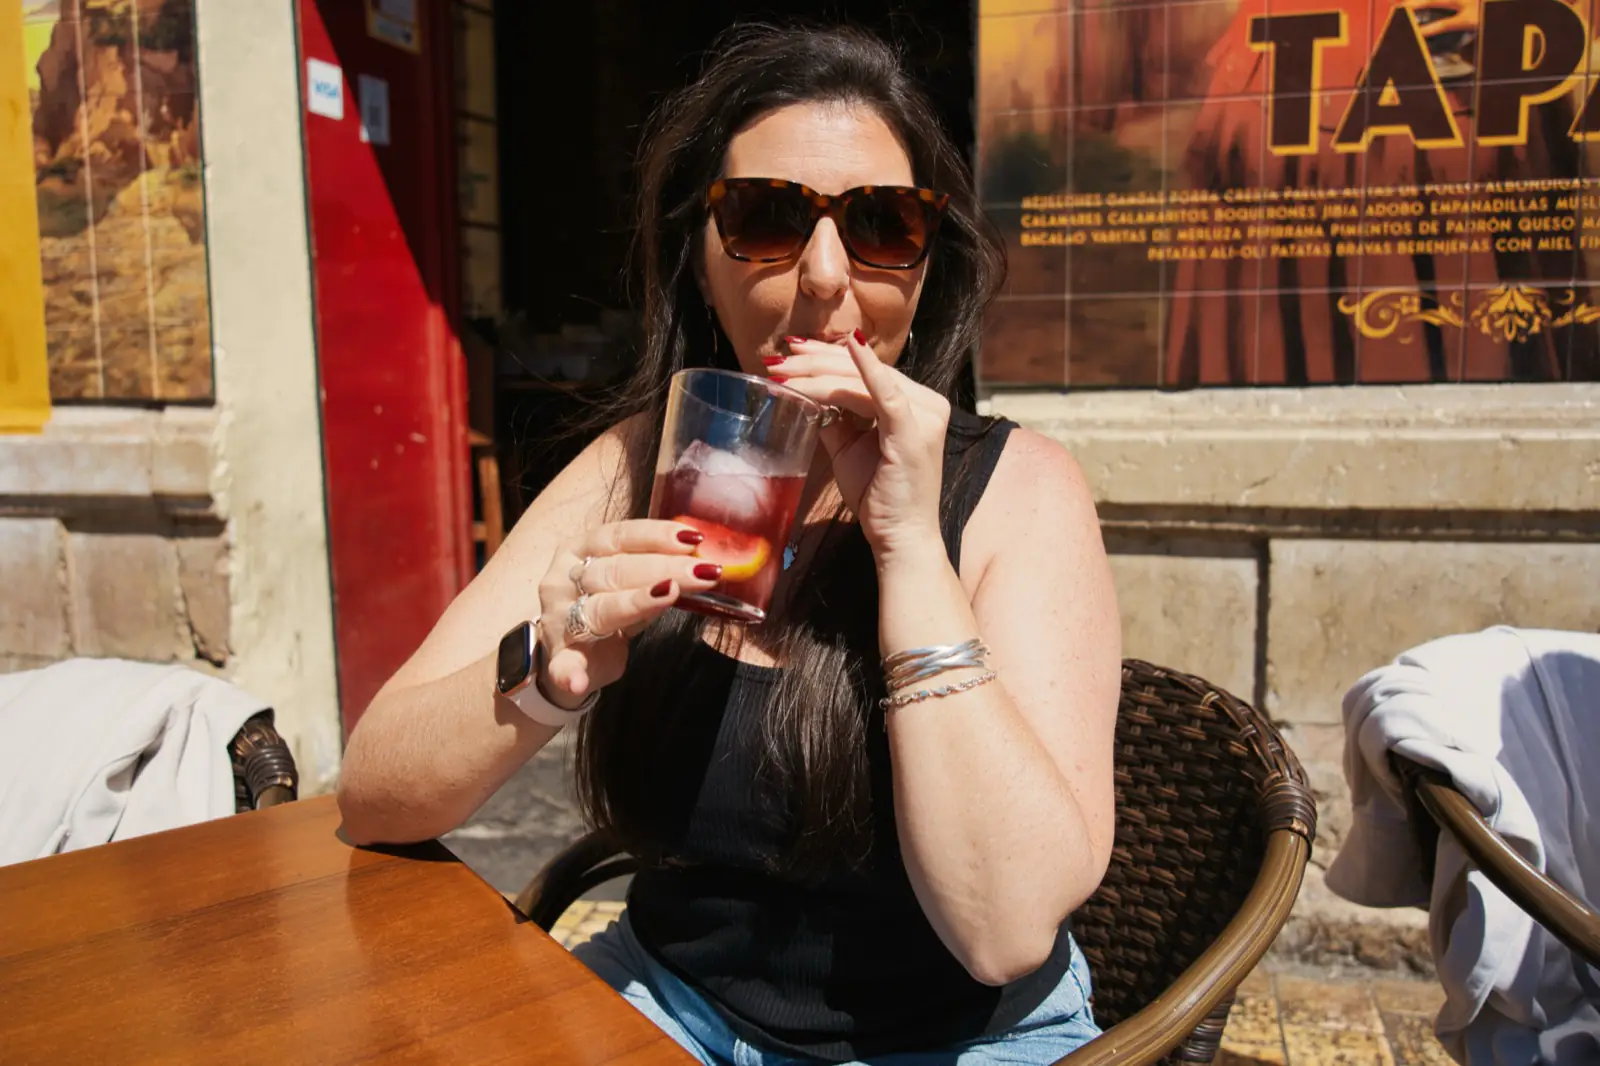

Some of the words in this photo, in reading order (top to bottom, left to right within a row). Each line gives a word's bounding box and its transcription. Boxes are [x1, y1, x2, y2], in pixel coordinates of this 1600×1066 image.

[1246, 0, 1600, 155] TAP
[1021, 211, 1102, 228] CALAMARES
[1107, 209, 1209, 225] CALAMARITOS
[1214, 205, 1316, 222] BOQUERONES
[1365, 201, 1424, 217] ADOBO
[1430, 196, 1548, 215] EMPANADILLAS
[1091, 228, 1147, 244] VARITAS
[1152, 227, 1172, 243] DE
[1176, 225, 1242, 242] MERLUZA
[1330, 220, 1412, 238] PIMIENTOS
[1418, 219, 1440, 235] DE
[1446, 215, 1513, 234] PADRÓN
[1518, 215, 1576, 232] QUESO
[1148, 246, 1207, 262] PATATAS
[1271, 242, 1331, 258] PATATAS
[1336, 241, 1392, 257] BRAVAS
[1397, 237, 1490, 256] BERENJENAS
[1495, 236, 1533, 252] CON
[1538, 235, 1573, 251] MIEL
